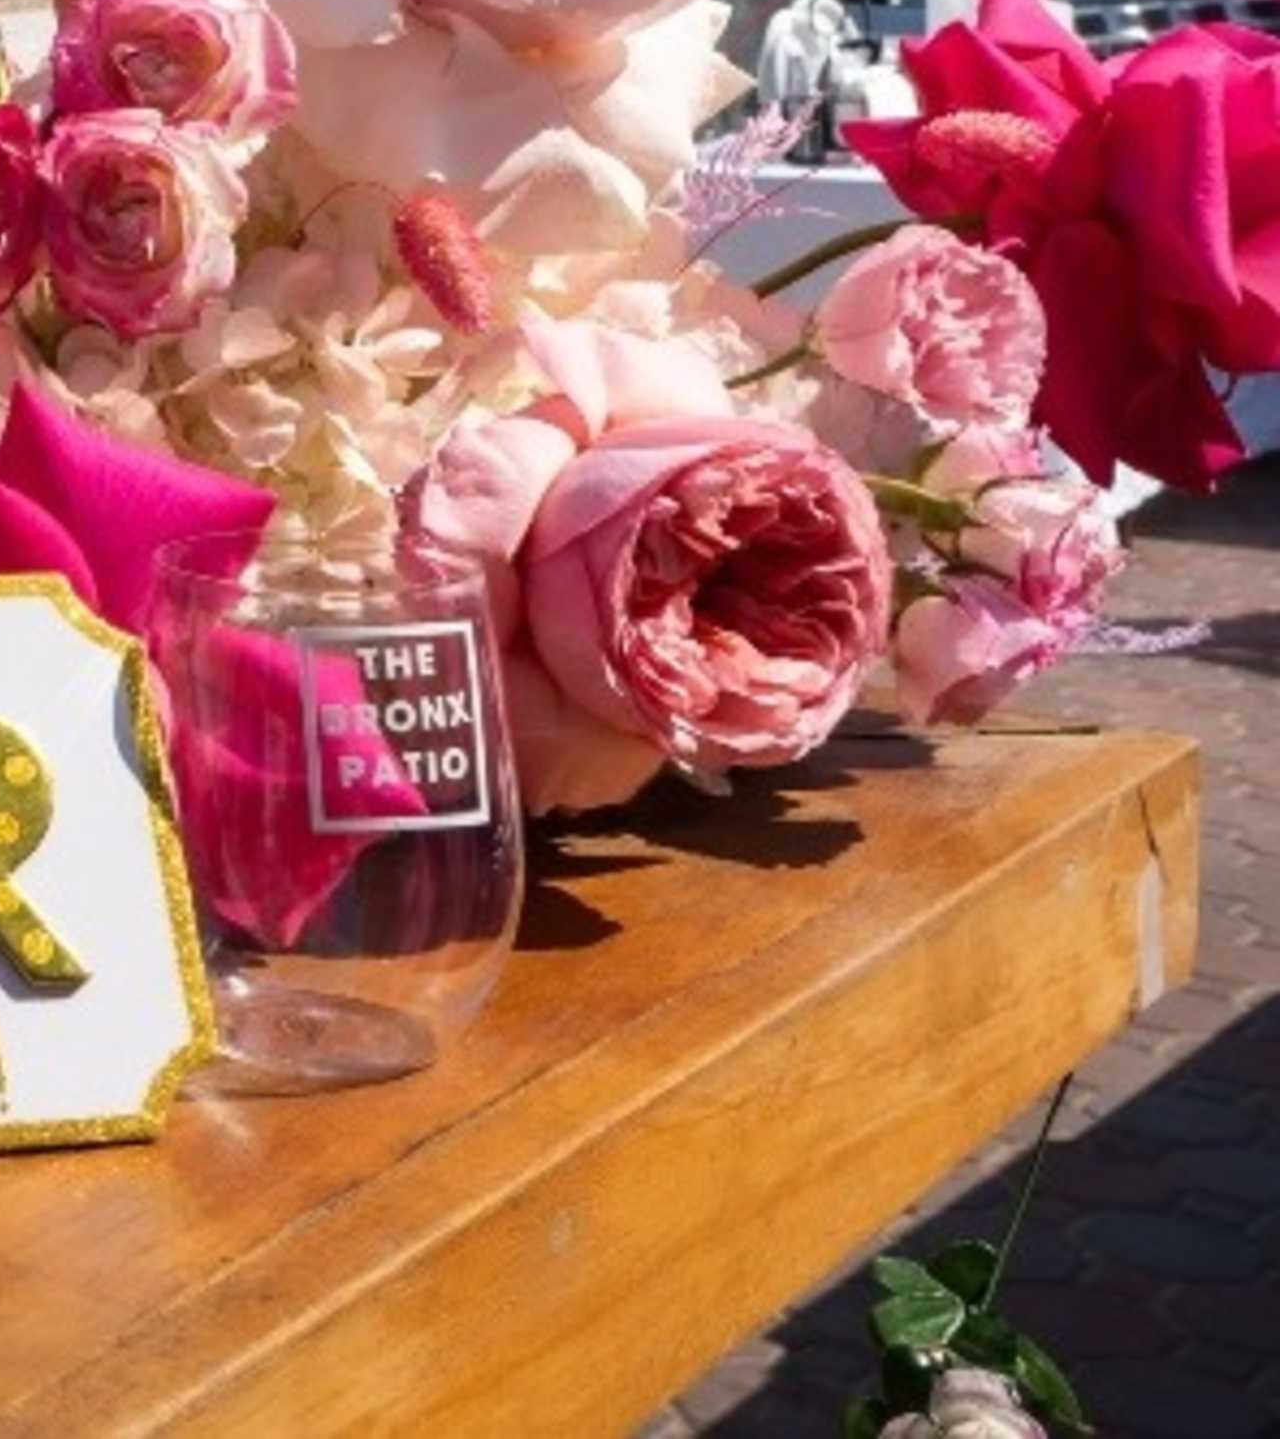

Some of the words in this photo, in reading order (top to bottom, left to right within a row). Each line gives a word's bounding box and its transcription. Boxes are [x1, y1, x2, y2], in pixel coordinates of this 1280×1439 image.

[356, 642, 437, 680] THE
[319, 690, 474, 739] BRONX
[337, 746, 469, 789] PATIO
